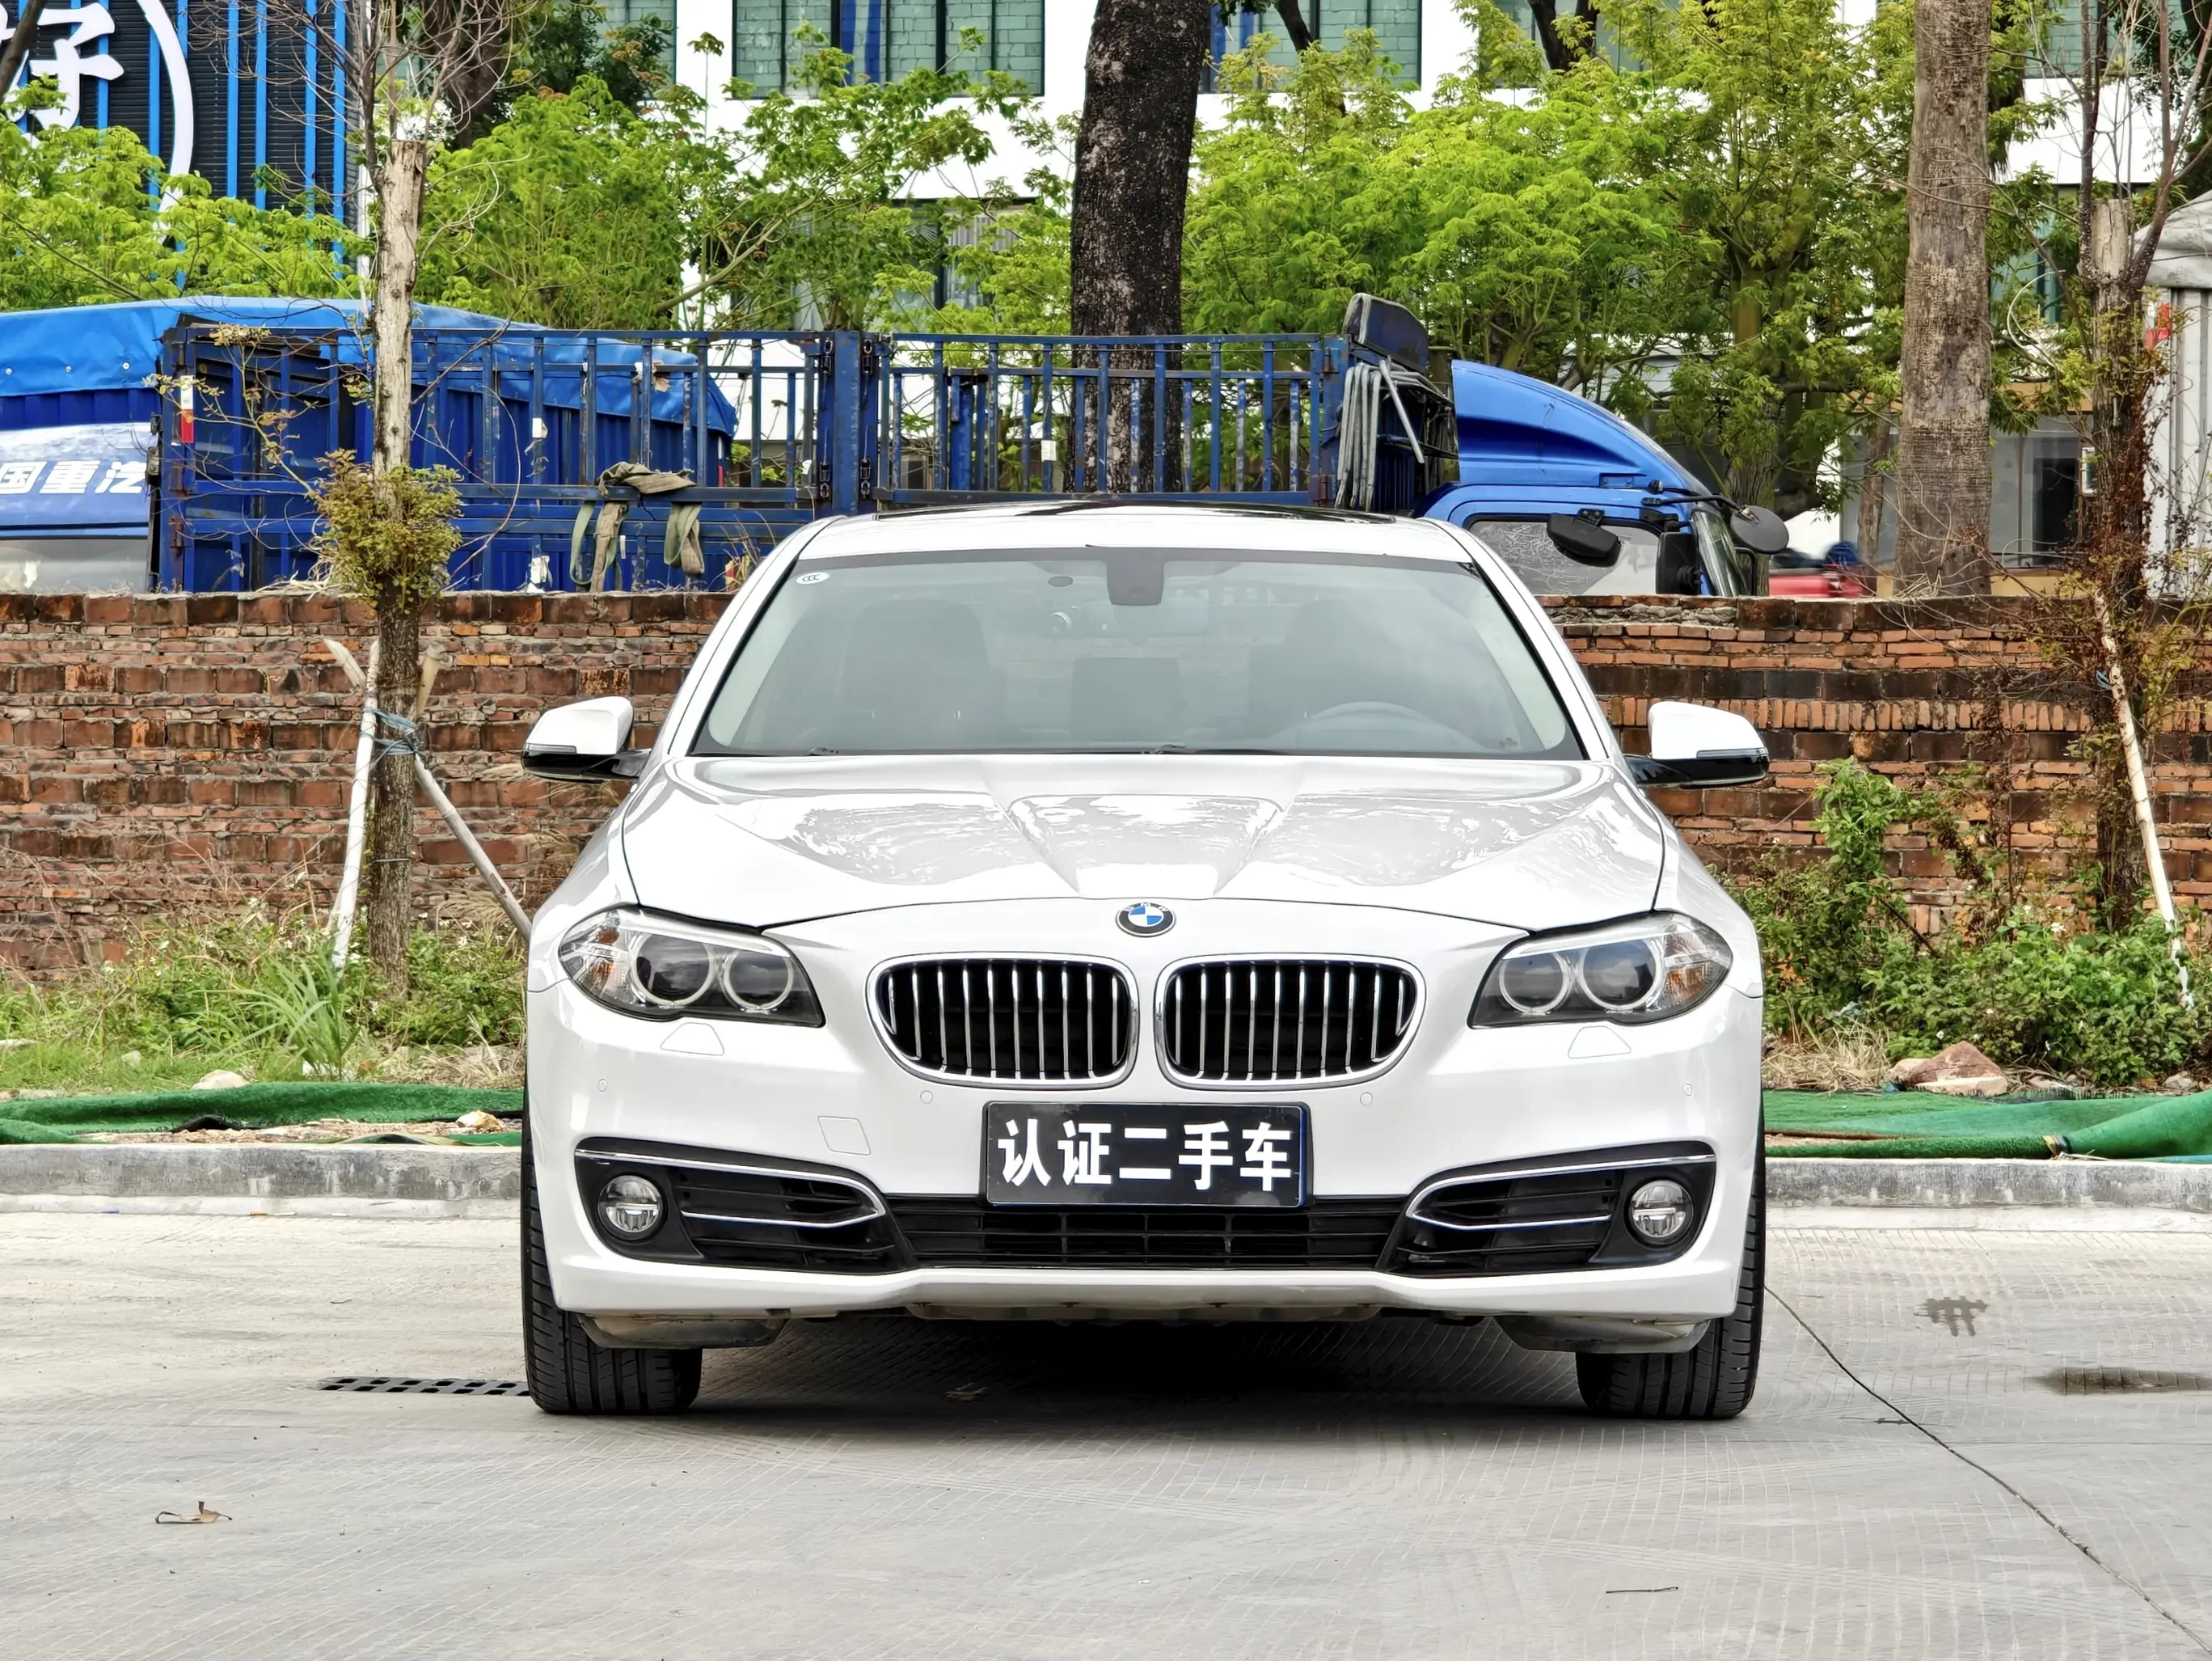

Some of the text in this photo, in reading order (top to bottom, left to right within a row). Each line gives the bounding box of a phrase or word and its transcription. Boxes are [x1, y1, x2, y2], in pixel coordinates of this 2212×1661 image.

[998, 1118, 1291, 1192] 认证二手车
